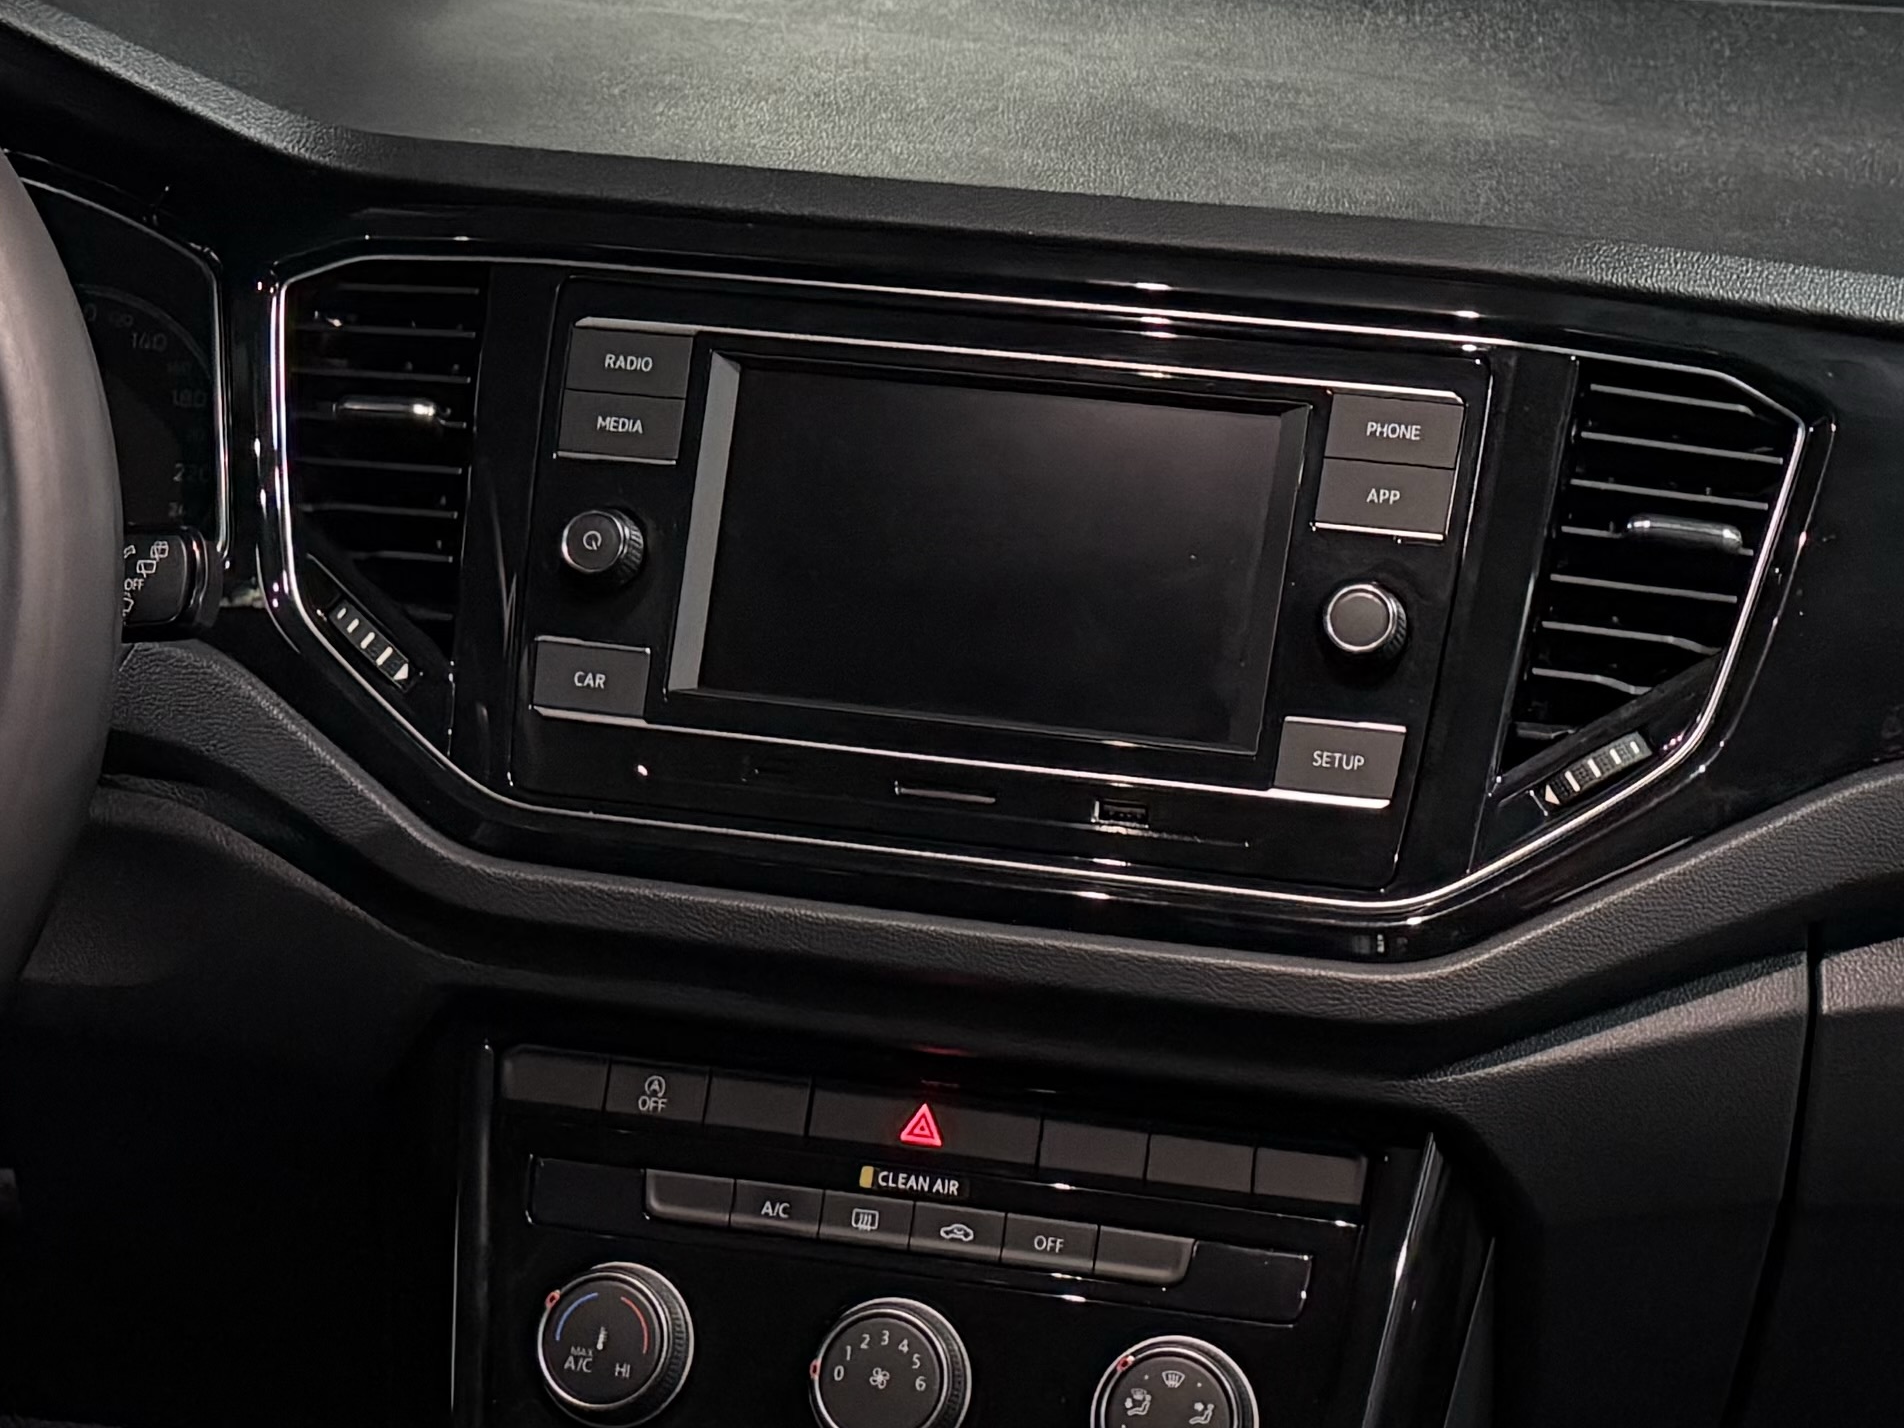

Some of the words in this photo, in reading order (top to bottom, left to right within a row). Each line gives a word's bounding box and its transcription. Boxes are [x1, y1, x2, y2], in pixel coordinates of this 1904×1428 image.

[604, 353, 653, 372] RADIO
[596, 415, 643, 434] MEDIA
[1366, 421, 1422, 441] PHONE
[1366, 487, 1401, 505] APP
[123, 576, 144, 591] OFF
[574, 671, 606, 690] CAR
[1312, 750, 1365, 771] SETUP
[638, 1095, 668, 1113] OFF
[878, 1171, 930, 1192] CLEAN
[933, 1178, 959, 1196] AIR
[761, 1201, 790, 1218] A/C
[1034, 1235, 1064, 1253] OFF
[860, 1333, 871, 1349] 2
[880, 1330, 890, 1346] 3
[898, 1338, 909, 1354] 4
[570, 1346, 594, 1357] MAX
[845, 1345, 852, 1361] 1
[564, 1356, 592, 1373] A/C
[912, 1353, 921, 1369] 5
[615, 1362, 631, 1378] HI
[833, 1365, 845, 1381] 0
[915, 1375, 926, 1391] 6
